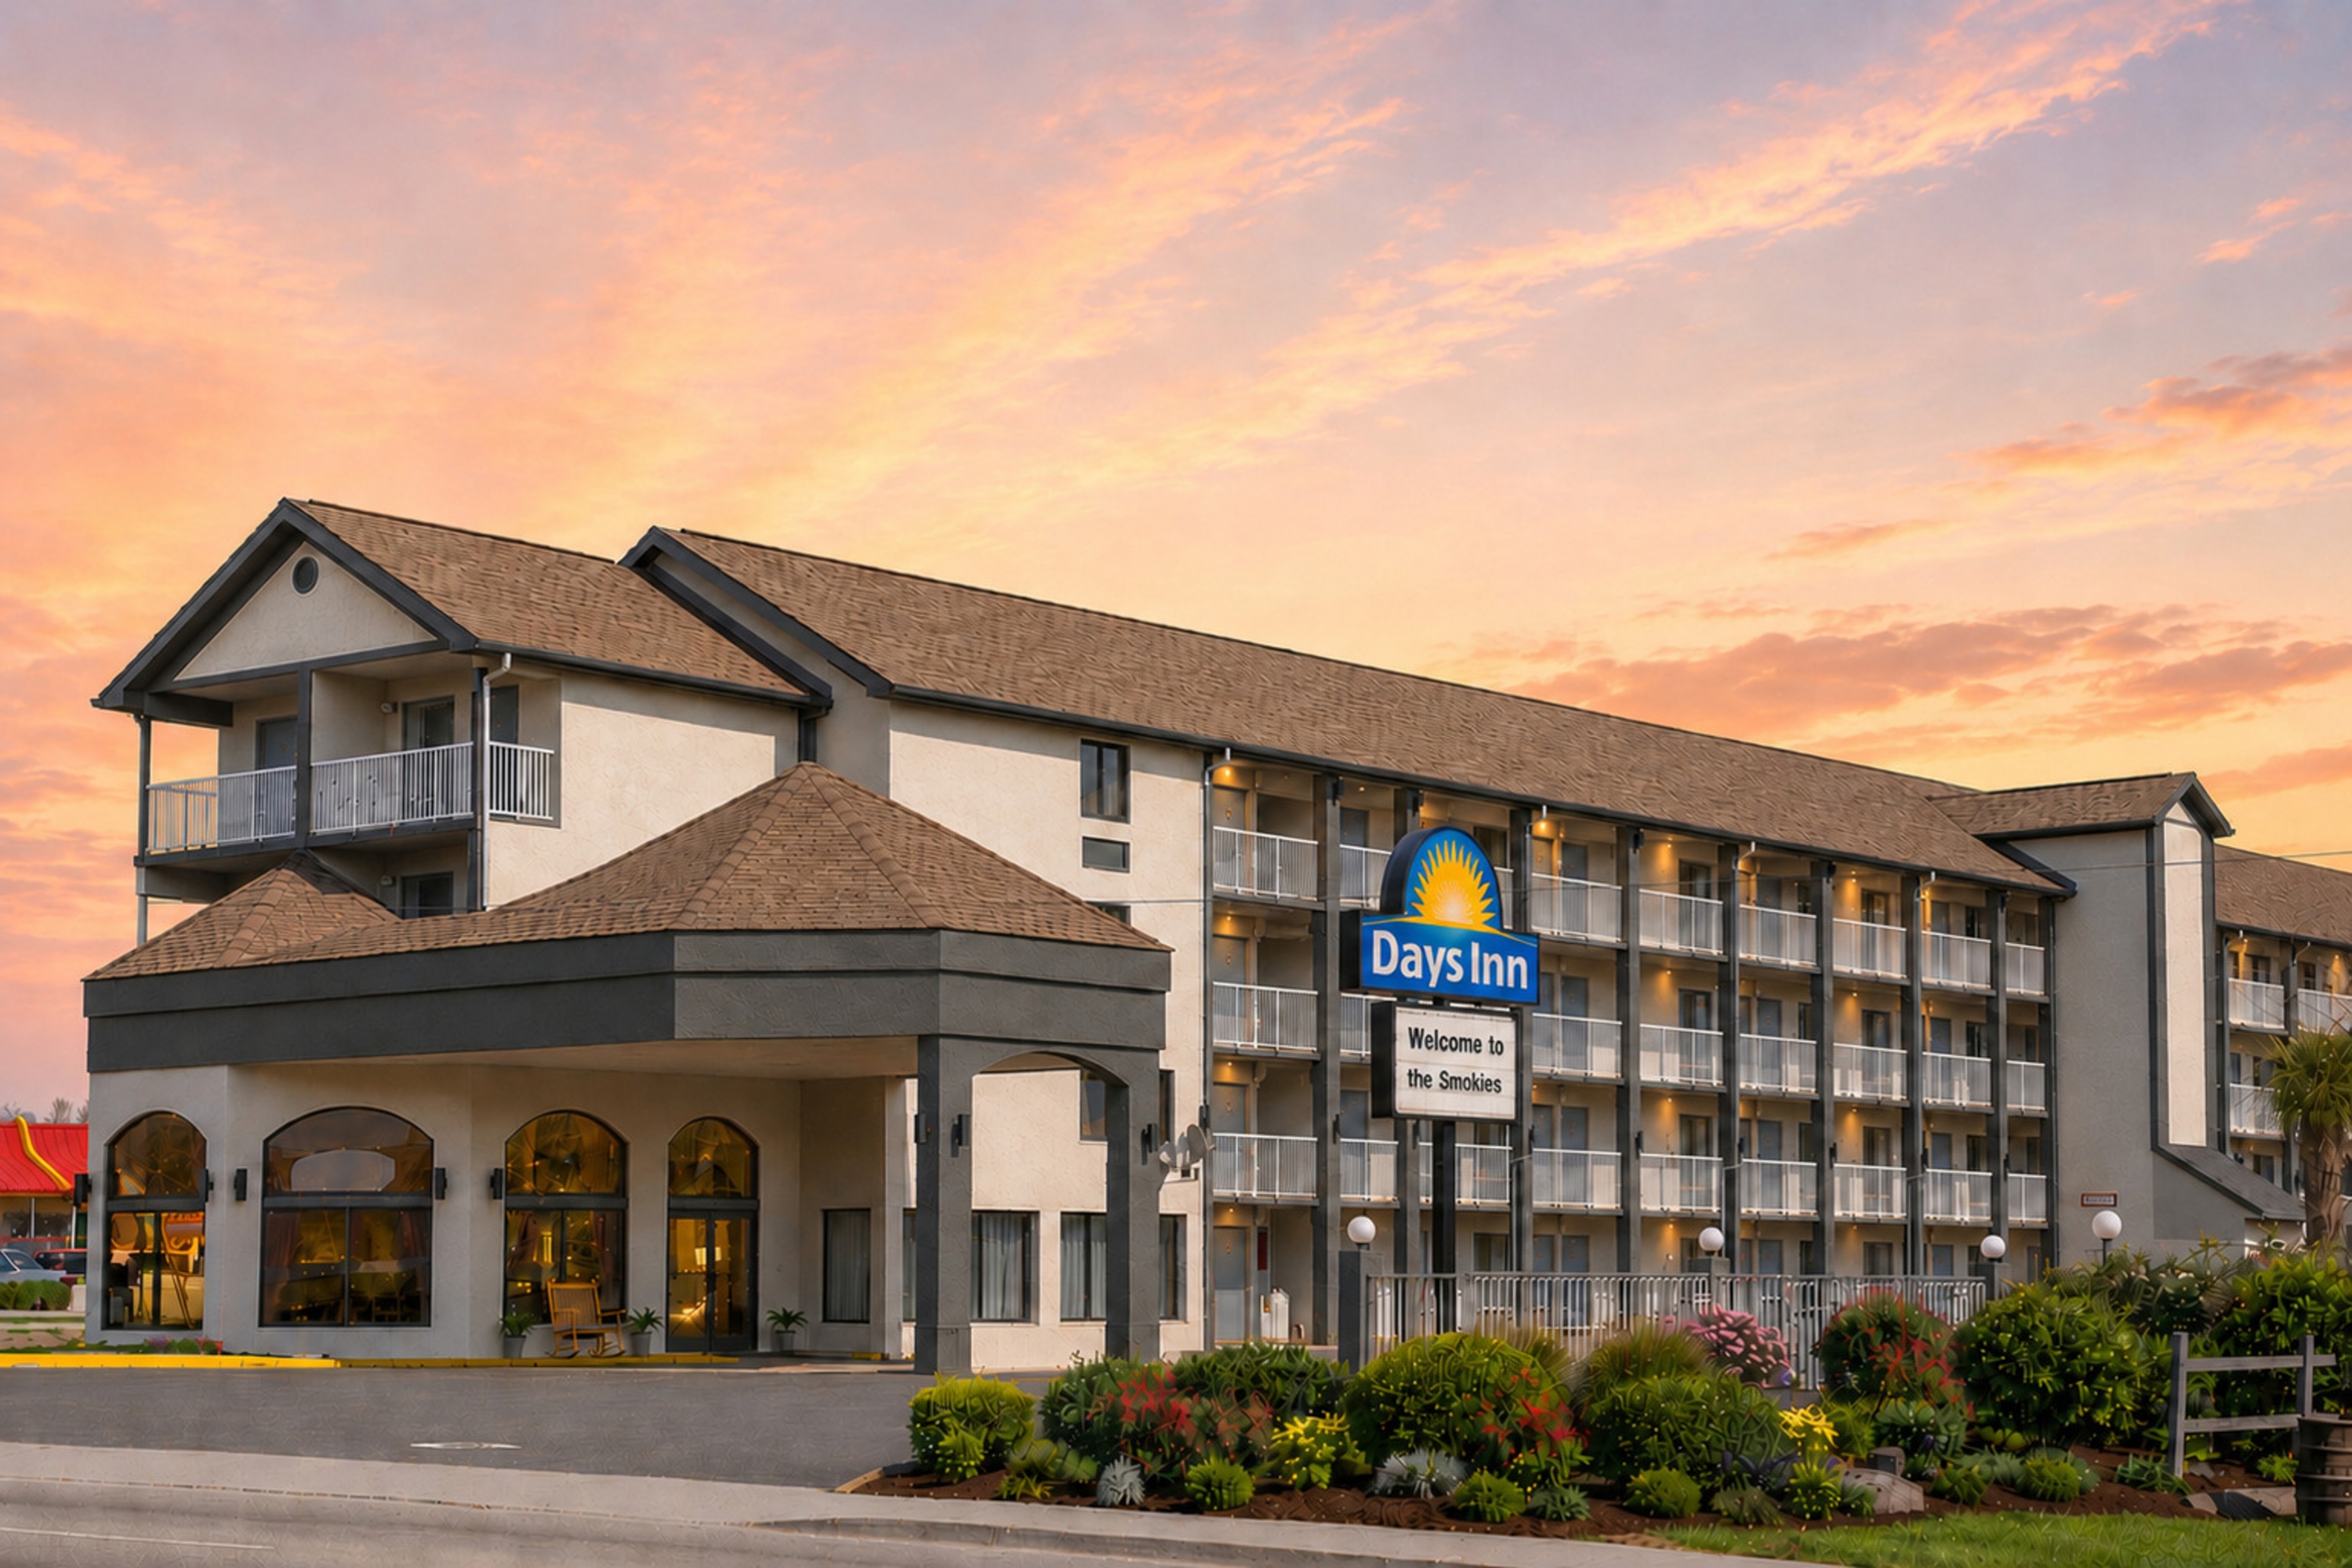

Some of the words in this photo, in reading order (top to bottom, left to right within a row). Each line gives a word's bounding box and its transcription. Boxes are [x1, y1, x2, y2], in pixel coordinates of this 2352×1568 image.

[1372, 930, 1464, 988] Days
[1471, 942, 1528, 989] Inn
[1408, 1026, 1482, 1053] Welcome
[1488, 1035, 1504, 1056] to
[1407, 1069, 1432, 1089] the
[1439, 1069, 1502, 1094] Smokies
